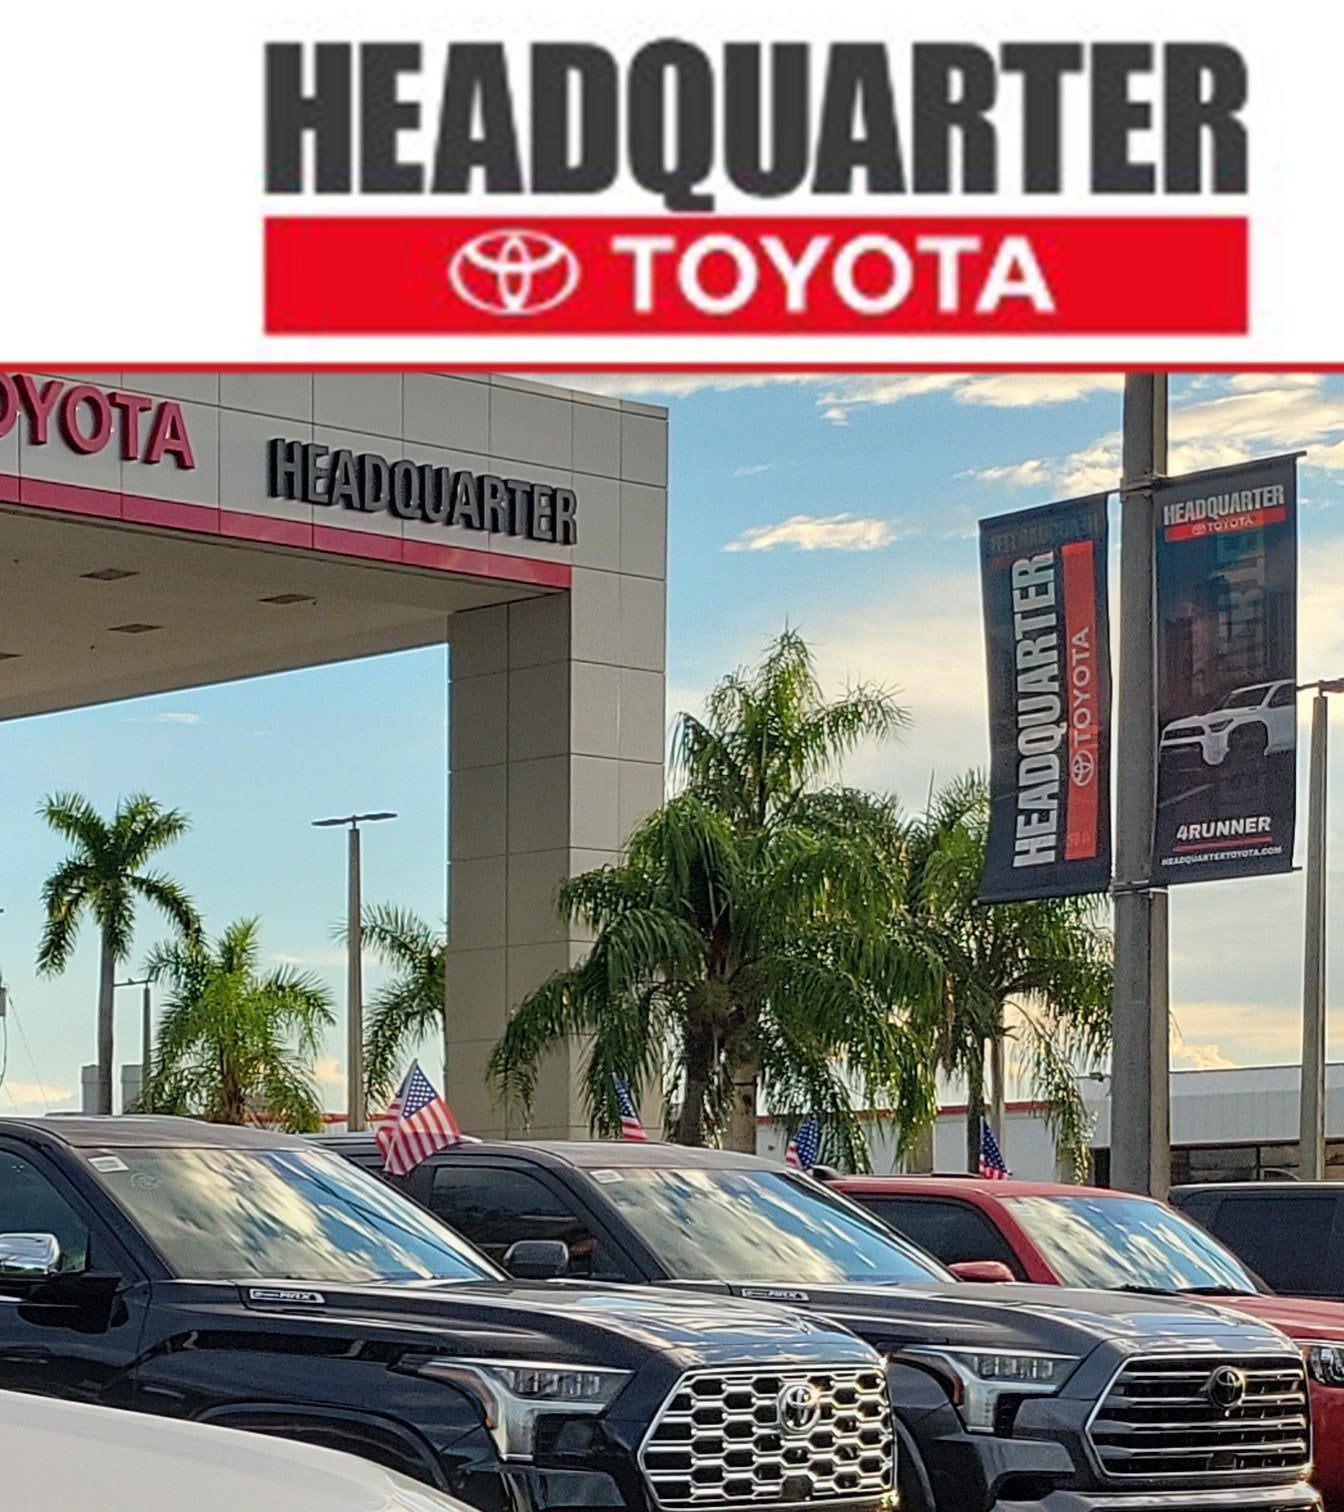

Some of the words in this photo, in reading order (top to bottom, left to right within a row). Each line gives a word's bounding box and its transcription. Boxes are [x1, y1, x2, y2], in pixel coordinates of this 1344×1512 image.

[268, 437, 578, 546] HEADQUARTER
[1162, 484, 1285, 526] HEADQUARTER
[1207, 515, 1254, 532] TOYOTA
[1071, 626, 1093, 748] TOYOTA
[1012, 550, 1067, 868] HEADQUARTER
[1175, 815, 1273, 841] 4RUNNER
[1160, 845, 1284, 867] HEADQUARTERTOYOTA.COM
